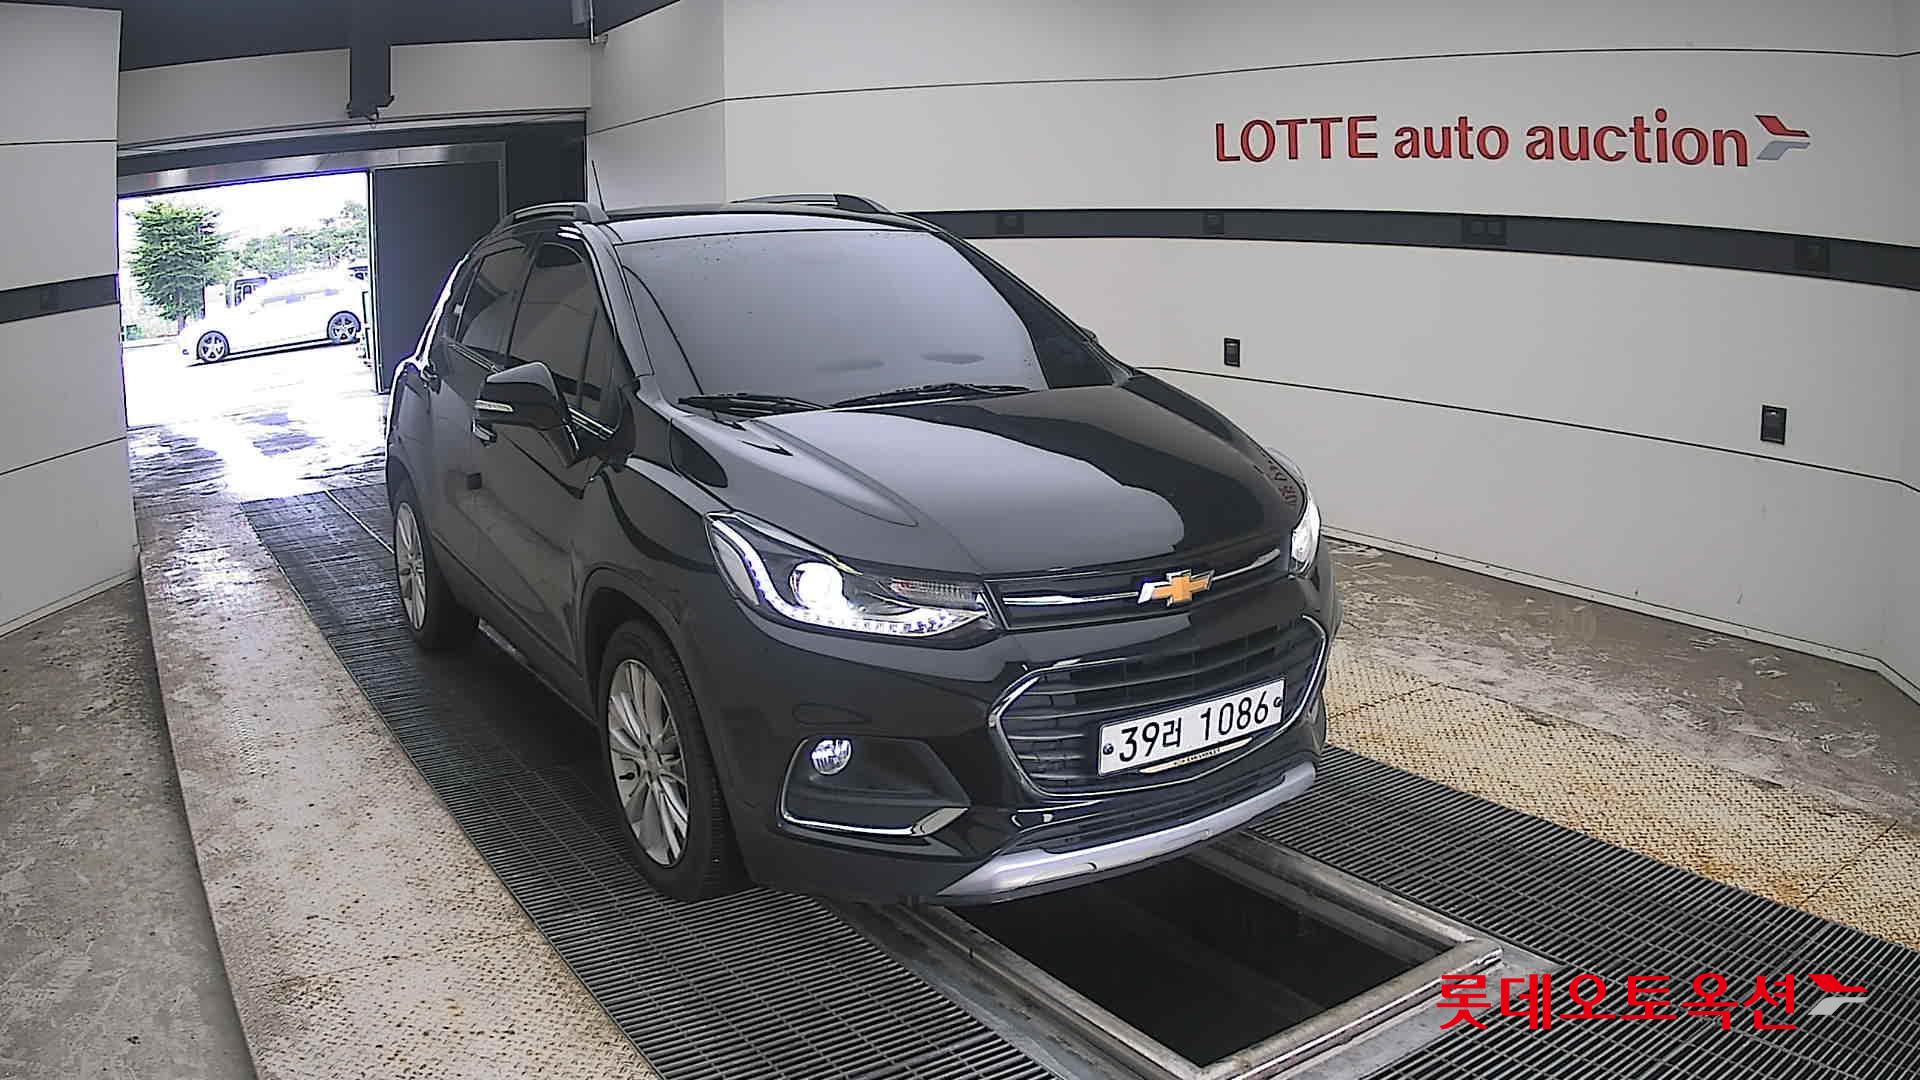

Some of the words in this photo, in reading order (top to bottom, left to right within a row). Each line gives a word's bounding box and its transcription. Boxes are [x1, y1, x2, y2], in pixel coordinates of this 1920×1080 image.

[1215, 115, 1379, 163] LOTTE
[1393, 115, 1510, 161] auto
[1525, 108, 1750, 167] auction
[1119, 716, 1183, 763] 39러
[1200, 690, 1270, 741] 1086
